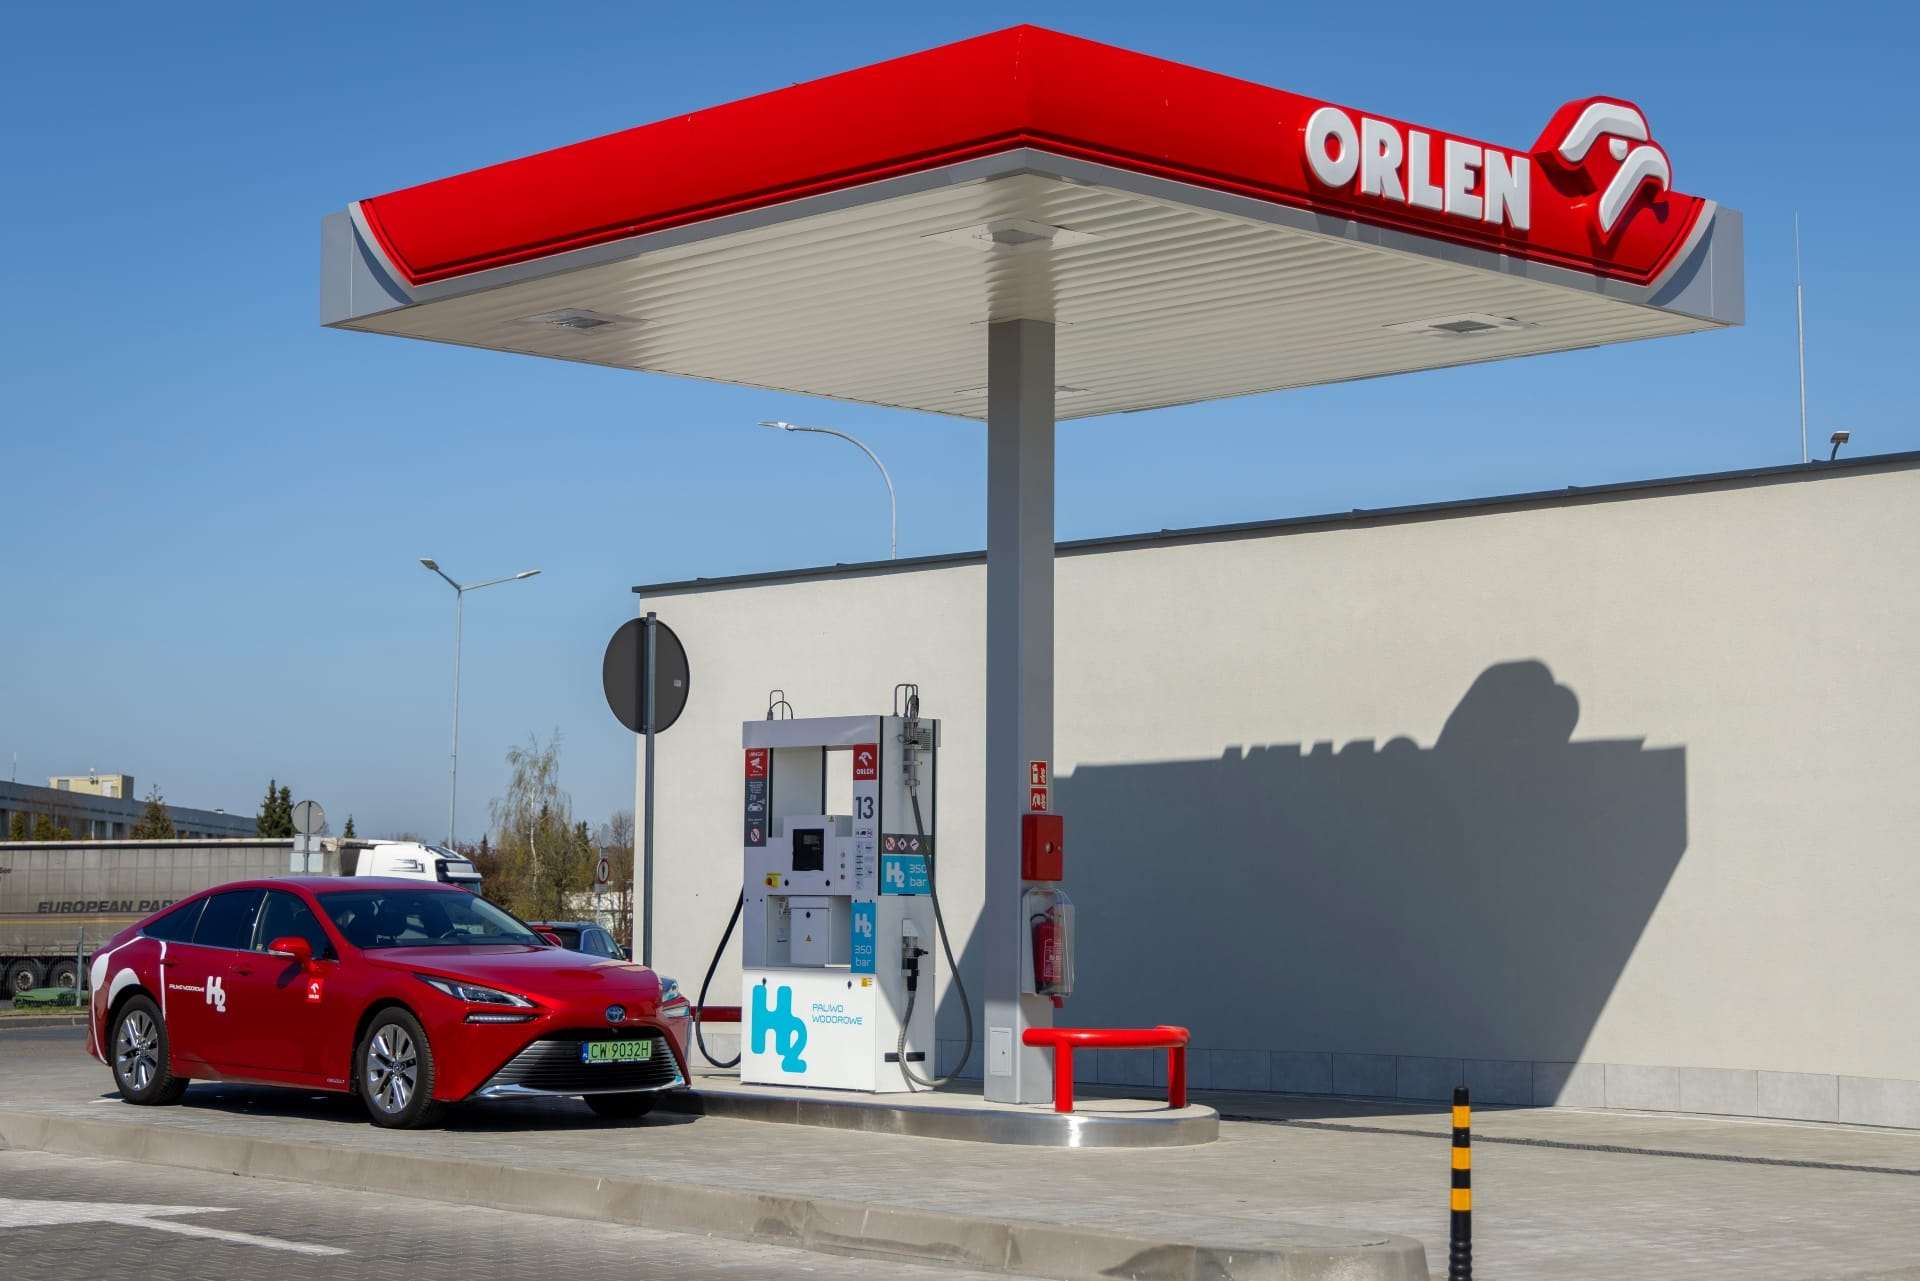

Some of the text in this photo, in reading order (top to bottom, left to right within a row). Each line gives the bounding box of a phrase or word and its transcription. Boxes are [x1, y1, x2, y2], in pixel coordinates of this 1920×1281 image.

[1304, 106, 1531, 231] ORLEN
[856, 796, 874, 819] 13
[886, 861, 905, 888] H2
[909, 864, 927, 874] 350
[909, 877, 927, 887] bar
[37, 900, 179, 914] EUROPEAN PAR
[855, 913, 872, 938] H2
[854, 945, 872, 955] 350
[855, 957, 872, 967] bar
[206, 975, 226, 1013] H2
[812, 1003, 844, 1013] PALIWO
[812, 1015, 864, 1025] WODOROWE
[751, 984, 808, 1074] H2
[591, 1044, 607, 1058] CW
[612, 1042, 649, 1057] 9032H
